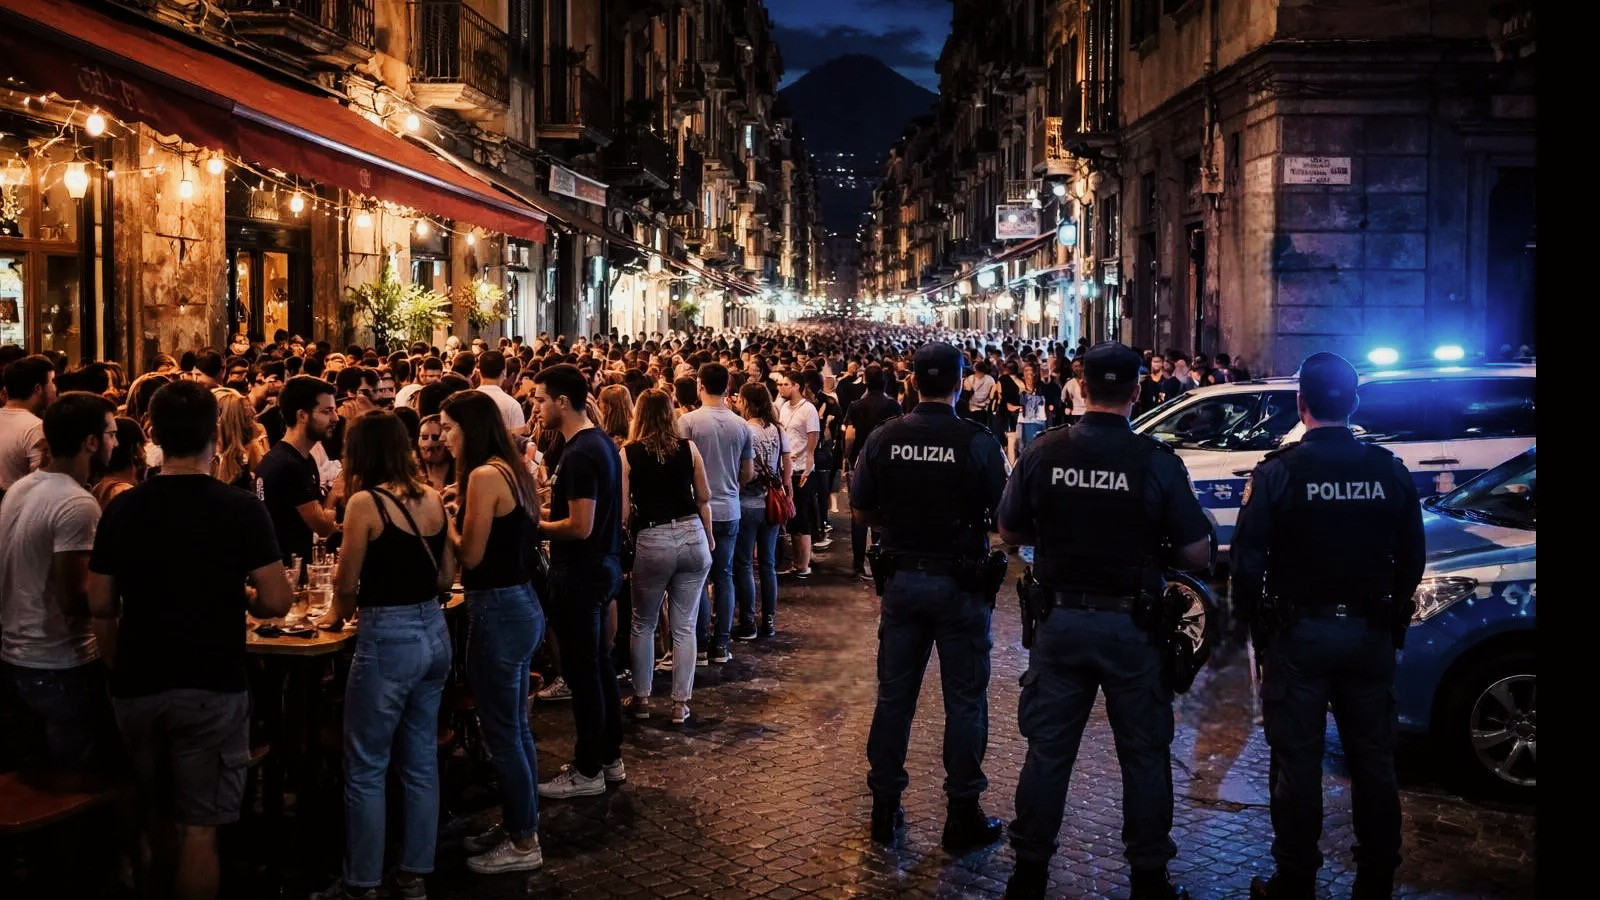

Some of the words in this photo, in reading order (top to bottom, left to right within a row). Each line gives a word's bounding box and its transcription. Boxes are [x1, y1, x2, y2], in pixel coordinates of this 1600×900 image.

[890, 444, 956, 463] POLIZIA
[1051, 467, 1130, 491] POLIZIA
[1306, 481, 1386, 501] POLIZIA
